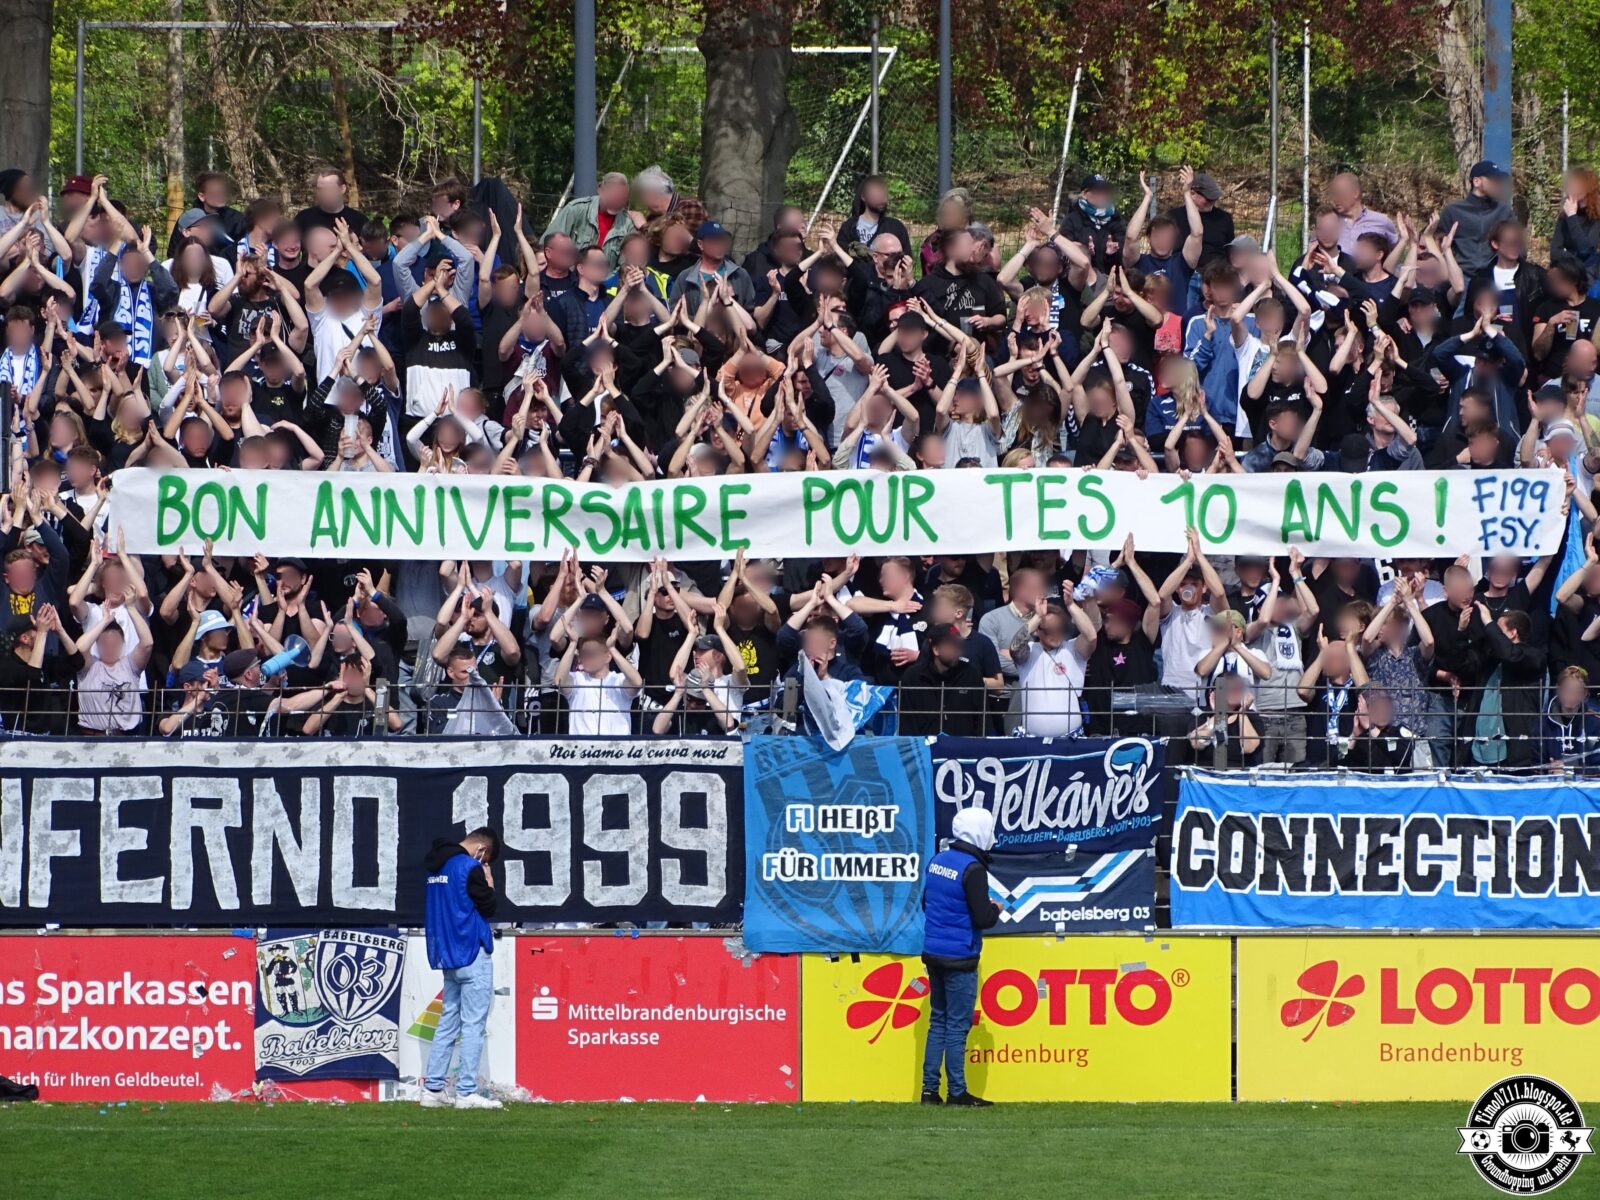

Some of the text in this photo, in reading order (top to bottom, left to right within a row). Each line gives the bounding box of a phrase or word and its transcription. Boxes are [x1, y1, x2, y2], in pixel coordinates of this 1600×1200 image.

[157, 474, 268, 547] BON
[311, 481, 752, 556] ANNIVERSAIRE
[803, 474, 938, 546] POUR
[983, 472, 1116, 542] TES
[1161, 481, 1238, 545] 10
[1281, 479, 1412, 548] ANS
[1478, 515, 1541, 552] FSY.
[550, 744, 729, 760] Noi siamo la curva nord
[788, 806, 813, 831] FI
[451, 770, 728, 908] 1999
[1175, 808, 1600, 896] CONNECTION
[764, 850, 918, 880] FÜR IMMER!
[928, 862, 959, 881] ORDNER
[1040, 906, 1151, 922] babelsberg 03
[322, 928, 406, 952] BABELSBERG
[324, 952, 387, 1001] 03
[0, 971, 253, 1014] s Sparkassen
[973, 968, 1173, 1028] OTTO
[1380, 967, 1600, 1026] LOTTO
[568, 1003, 787, 1025] Mittelbrandenburgische
[260, 1024, 399, 1059] Babelsberg
[567, 1028, 660, 1049] Sparkasse
[288, 1056, 316, 1068] 1903
[1379, 1042, 1524, 1067] Brandenburg
[44, 1071, 67, 1087] für
[70, 1071, 110, 1087] Ihren
[115, 1071, 204, 1087] Geldbeutel.
